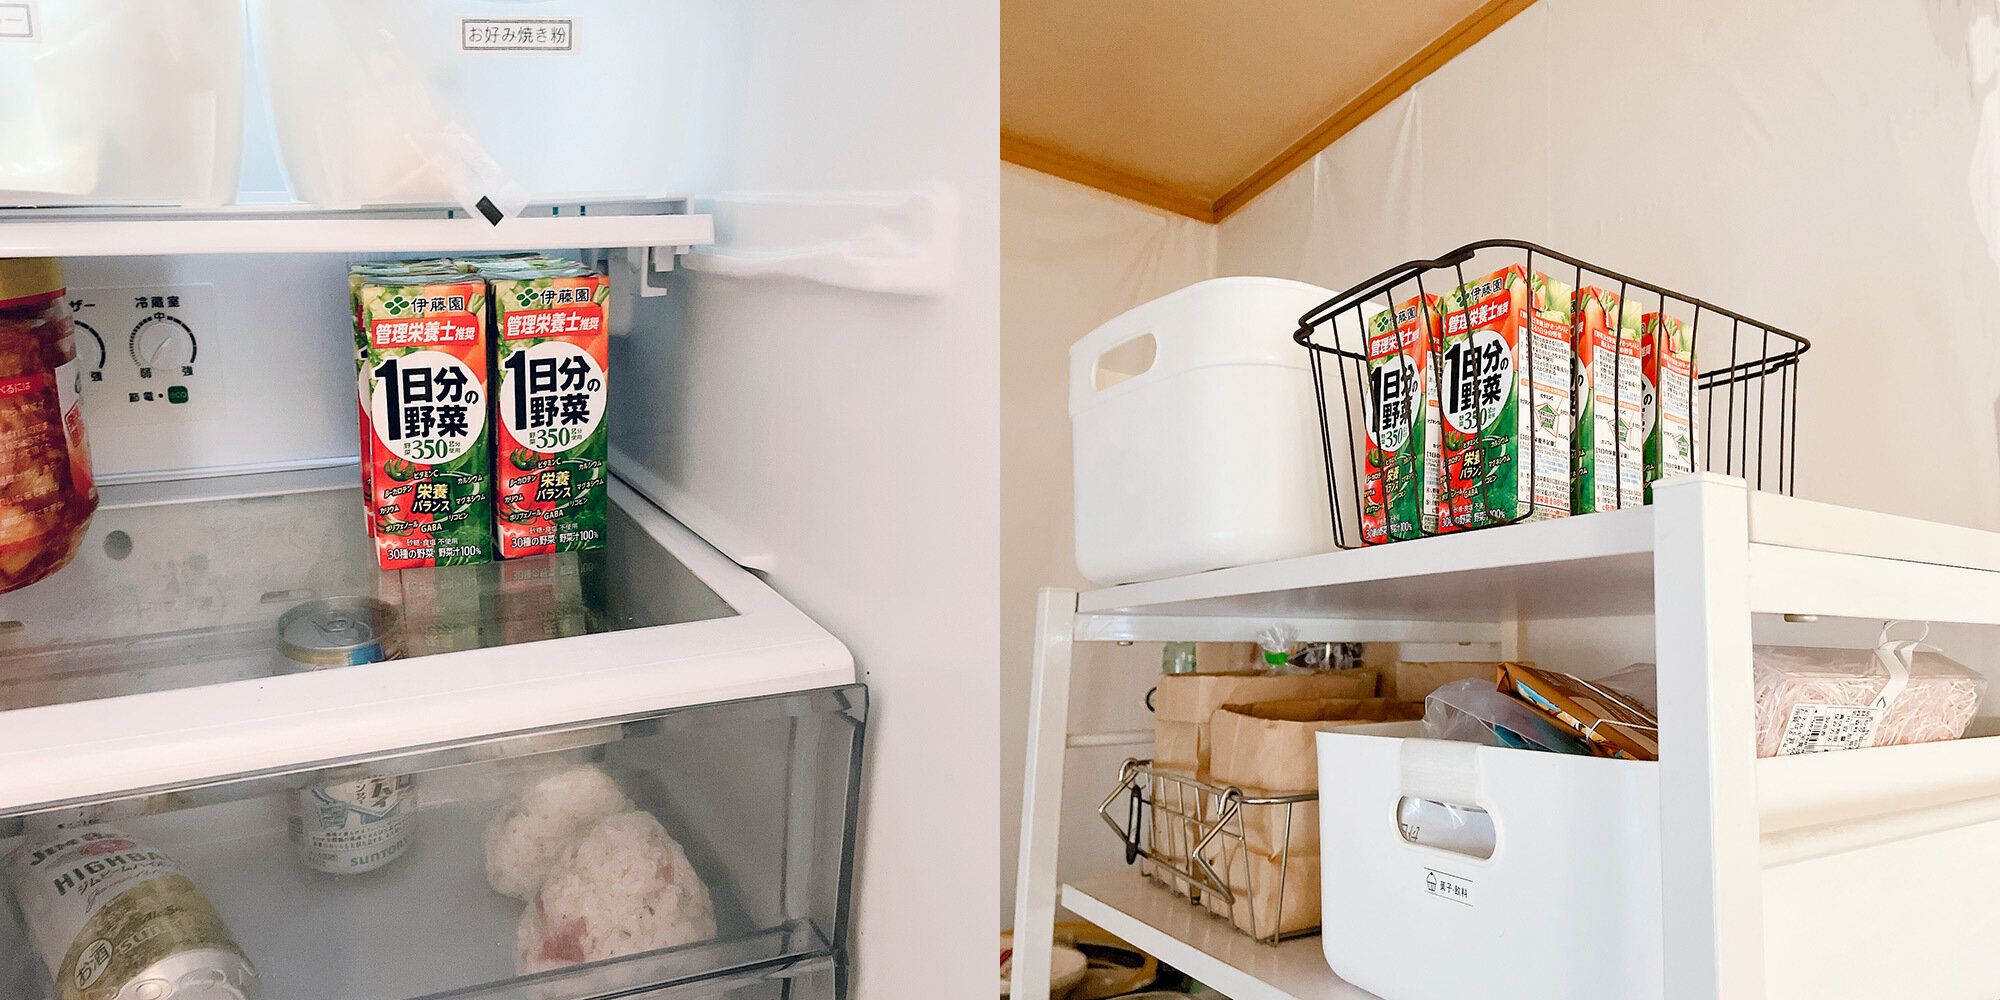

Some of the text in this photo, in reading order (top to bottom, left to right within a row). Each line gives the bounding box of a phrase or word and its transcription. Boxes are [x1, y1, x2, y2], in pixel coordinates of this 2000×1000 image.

[468, 26, 567, 44] お好み焼き粉
[540, 288, 590, 305] 伊藤園
[1470, 278, 1503, 301] 伊藤園
[411, 296, 464, 313] 伊藤園
[153, 311, 165, 322] 中
[507, 311, 600, 336] 管理栄養士推奨
[375, 320, 476, 344] 管理栄養士推奨
[530, 393, 590, 428] 野菜
[404, 404, 468, 439] 野菜
[413, 469, 439, 479] ビタミンC
[540, 471, 571, 487] 栄養
[416, 483, 449, 500] 栄養
[536, 487, 571, 501] バランス
[413, 500, 450, 513] バランス
[543, 510, 564, 520] GABA
[421, 522, 442, 533] GABA
[78, 941, 110, 986] お酒
